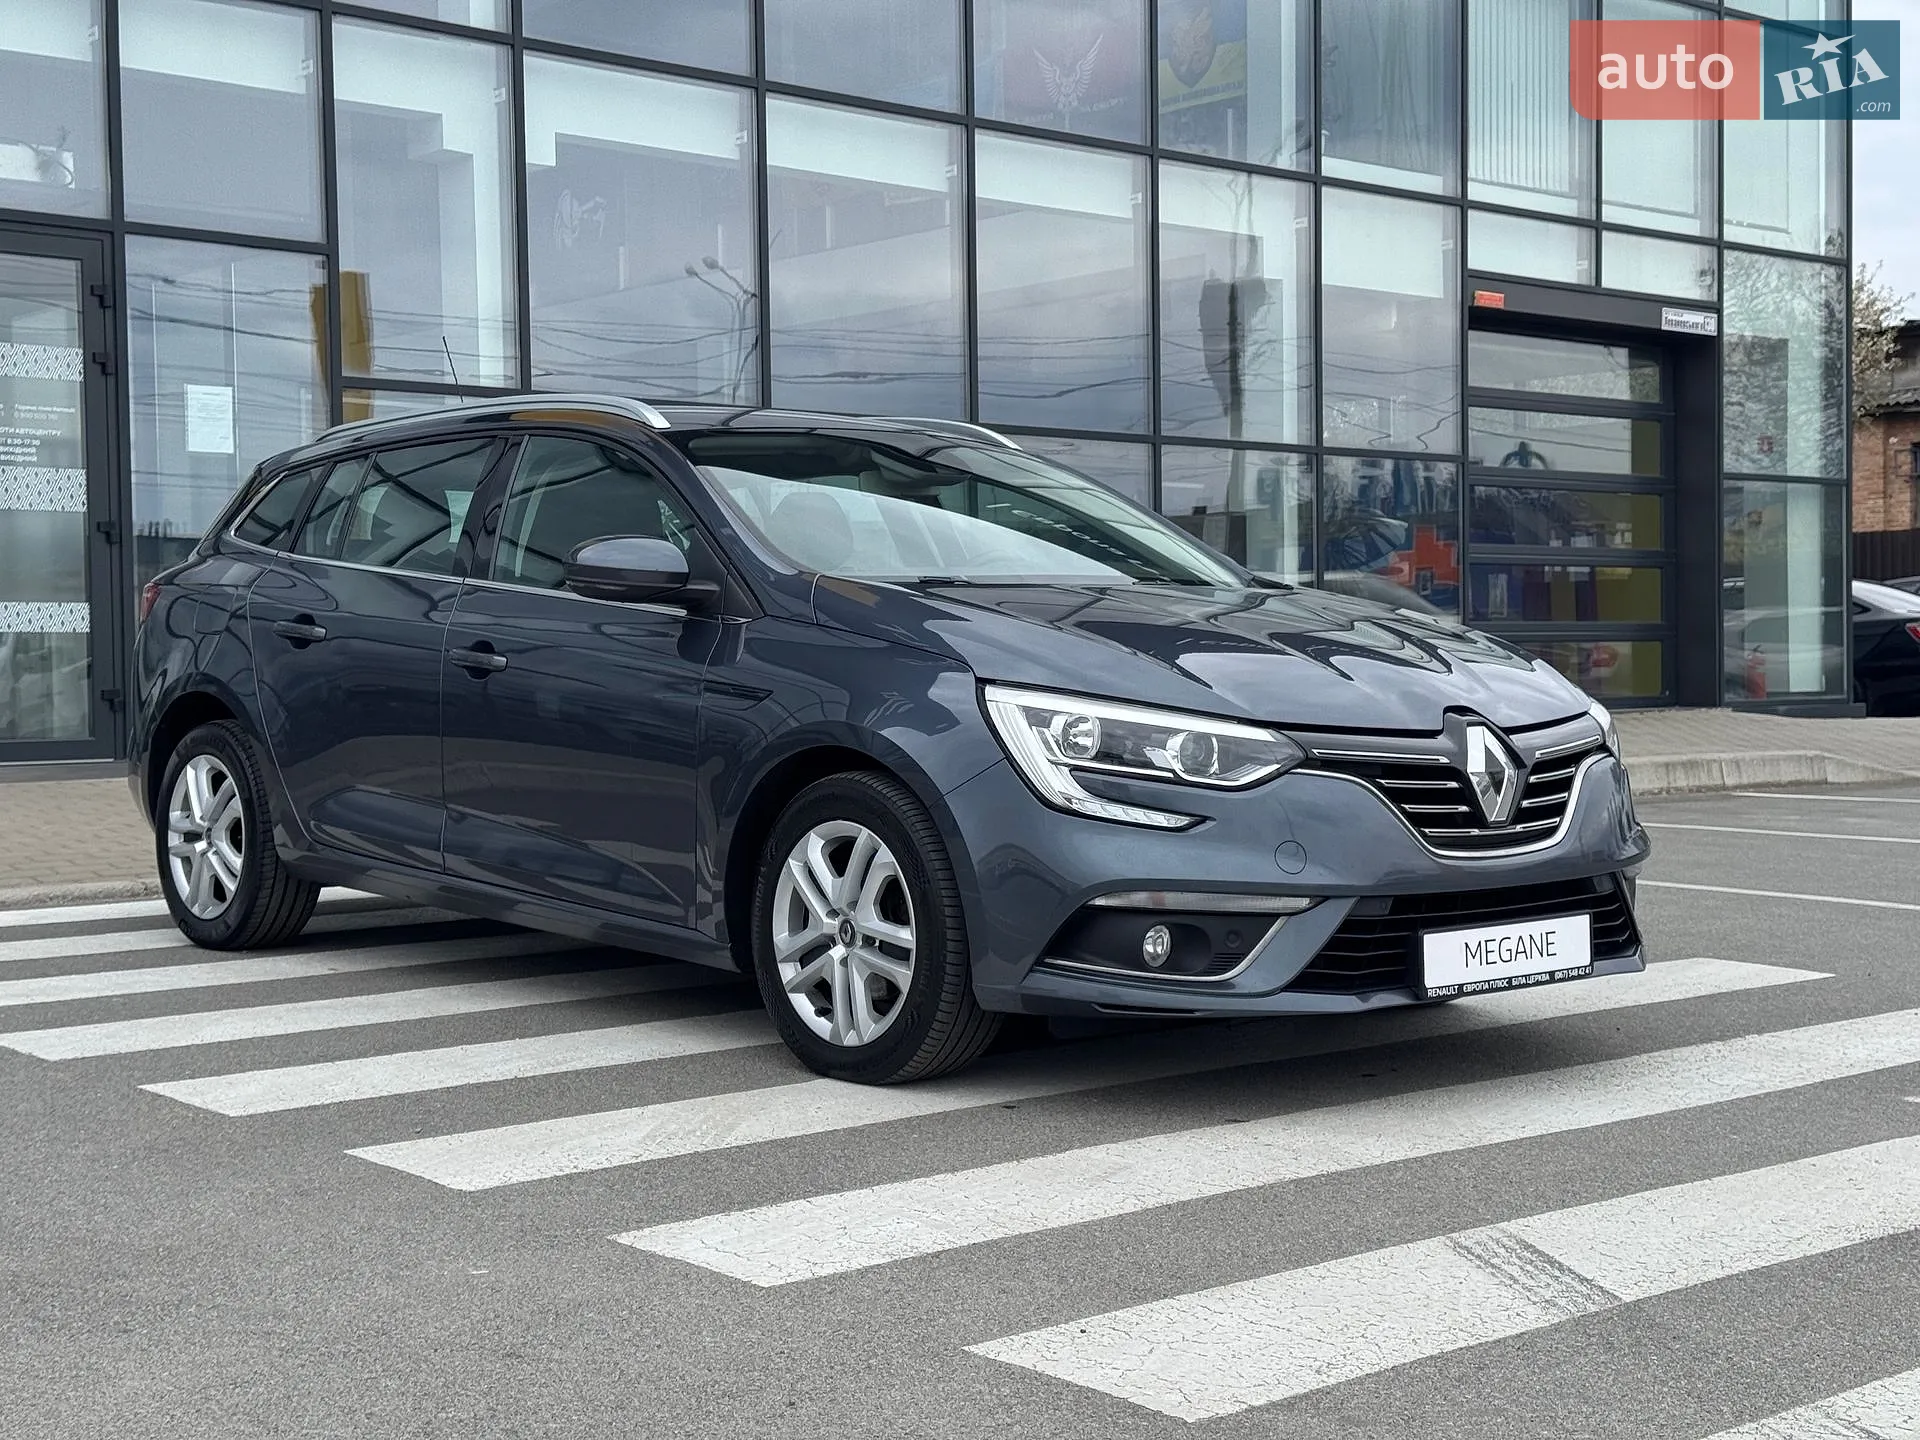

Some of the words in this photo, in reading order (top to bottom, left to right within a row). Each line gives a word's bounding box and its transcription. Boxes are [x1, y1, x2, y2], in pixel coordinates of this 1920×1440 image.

[1464, 930, 1557, 968] MEGANE
[1427, 985, 1459, 998] RENAULT
[1463, 981, 1490, 993] ЄВРОПА
